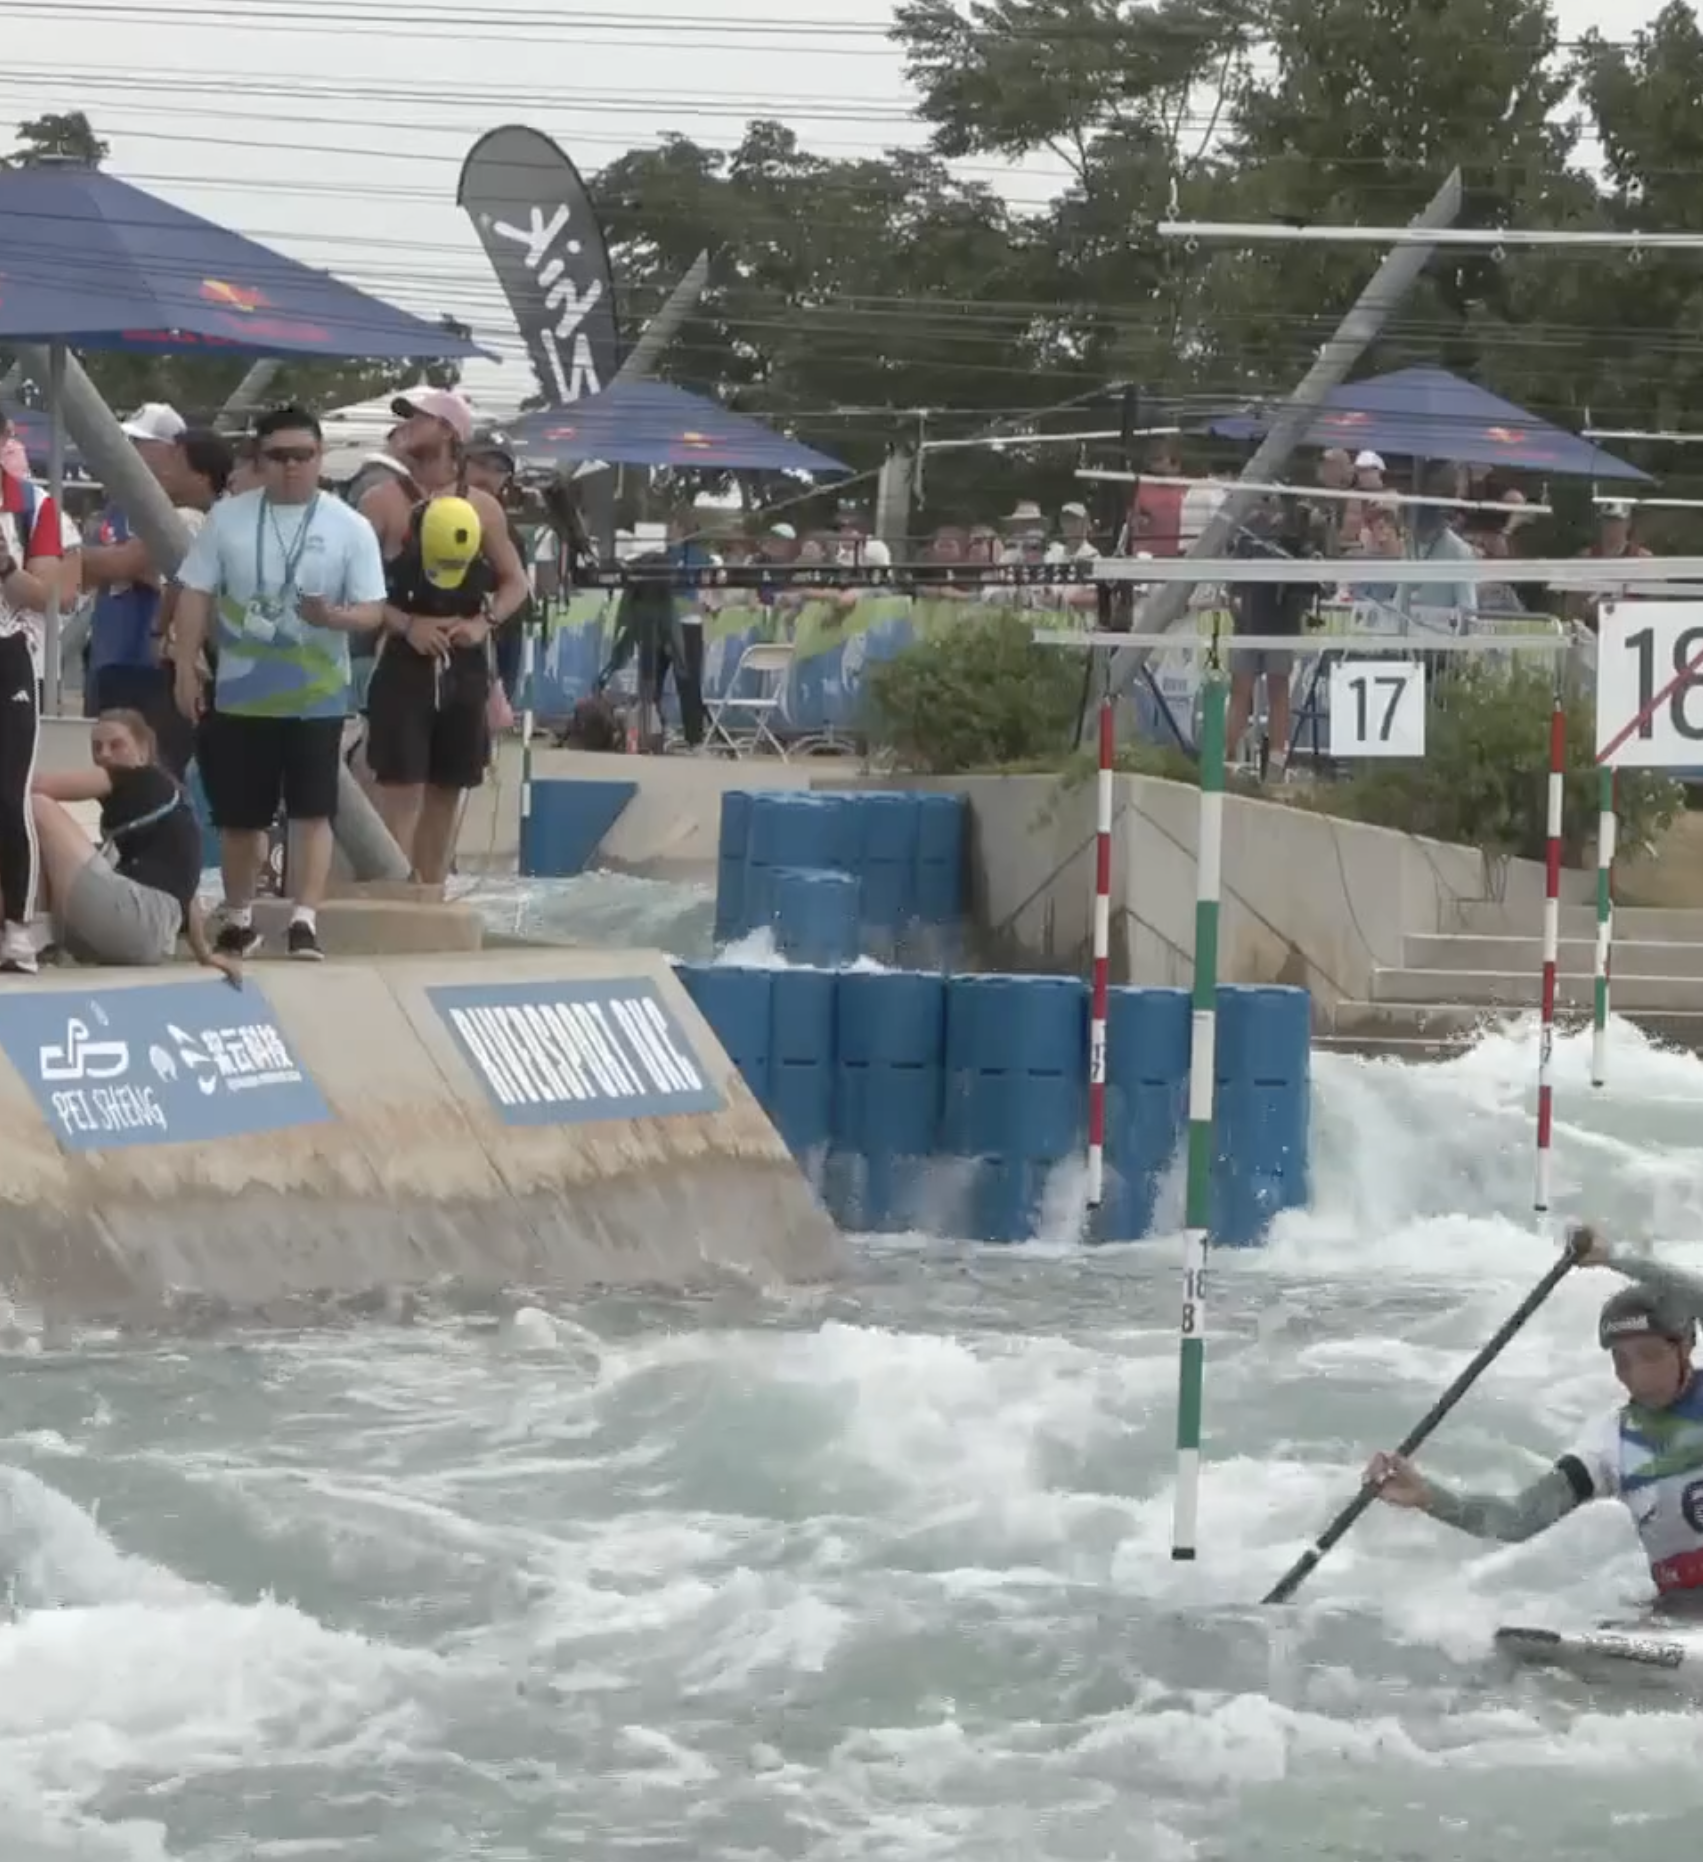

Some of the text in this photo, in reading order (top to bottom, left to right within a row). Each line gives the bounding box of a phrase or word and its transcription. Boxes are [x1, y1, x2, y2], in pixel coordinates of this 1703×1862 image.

[1349, 676, 1407, 741] 17
[449, 996, 702, 1105] RIVERSPORT OKC
[51, 1082, 168, 1136] PEI SHENG
